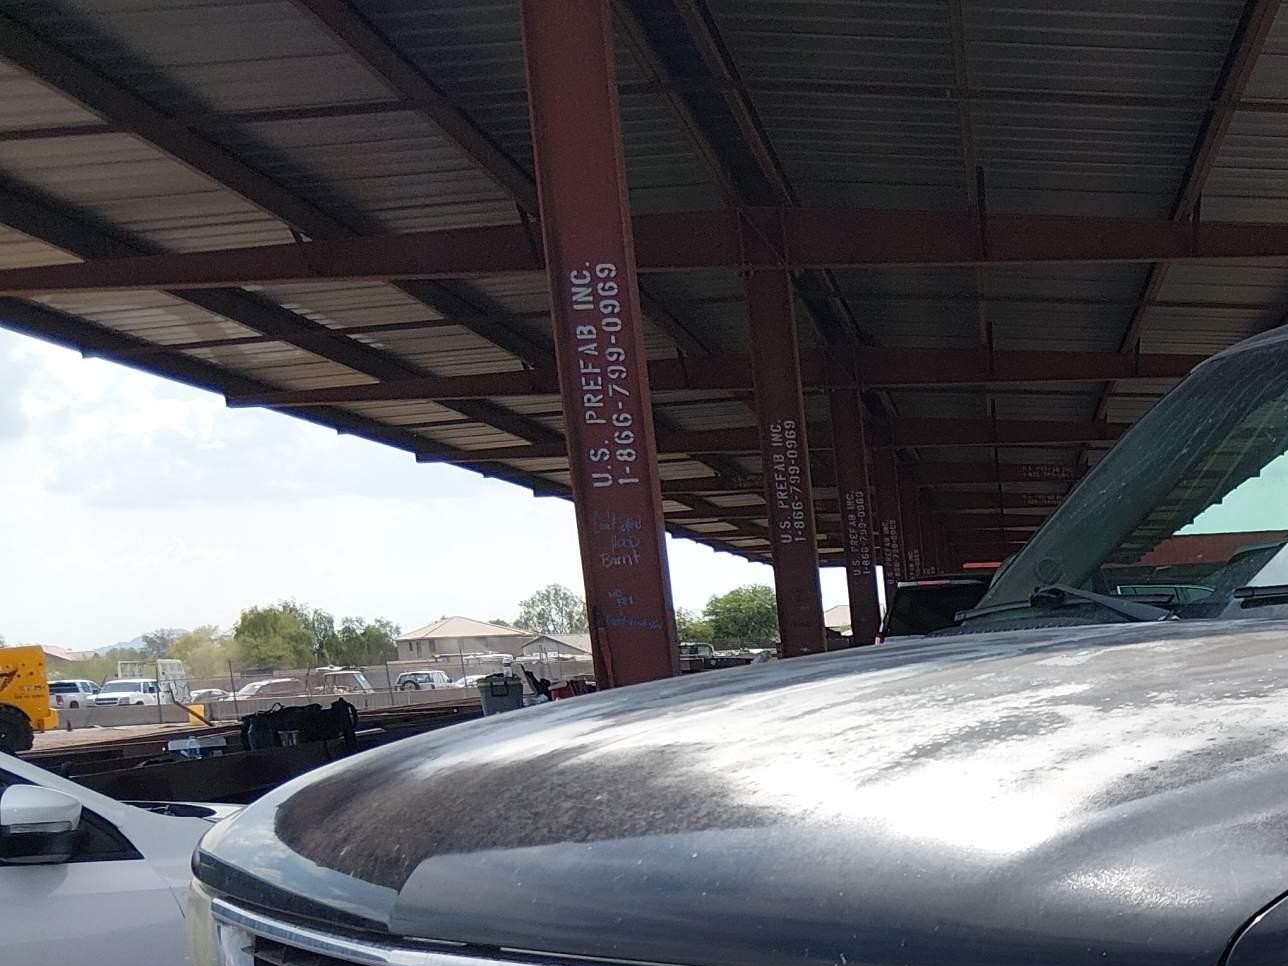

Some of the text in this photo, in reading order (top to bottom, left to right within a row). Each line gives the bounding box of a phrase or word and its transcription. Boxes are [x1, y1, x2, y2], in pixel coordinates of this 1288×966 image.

[570, 261, 613, 487] U.S. PREFAB INC.
[596, 263, 640, 485] 1-866-799-0969
[770, 420, 793, 543] U.S. PREFAB INC.
[784, 420, 806, 541] 1-866-799-0969
